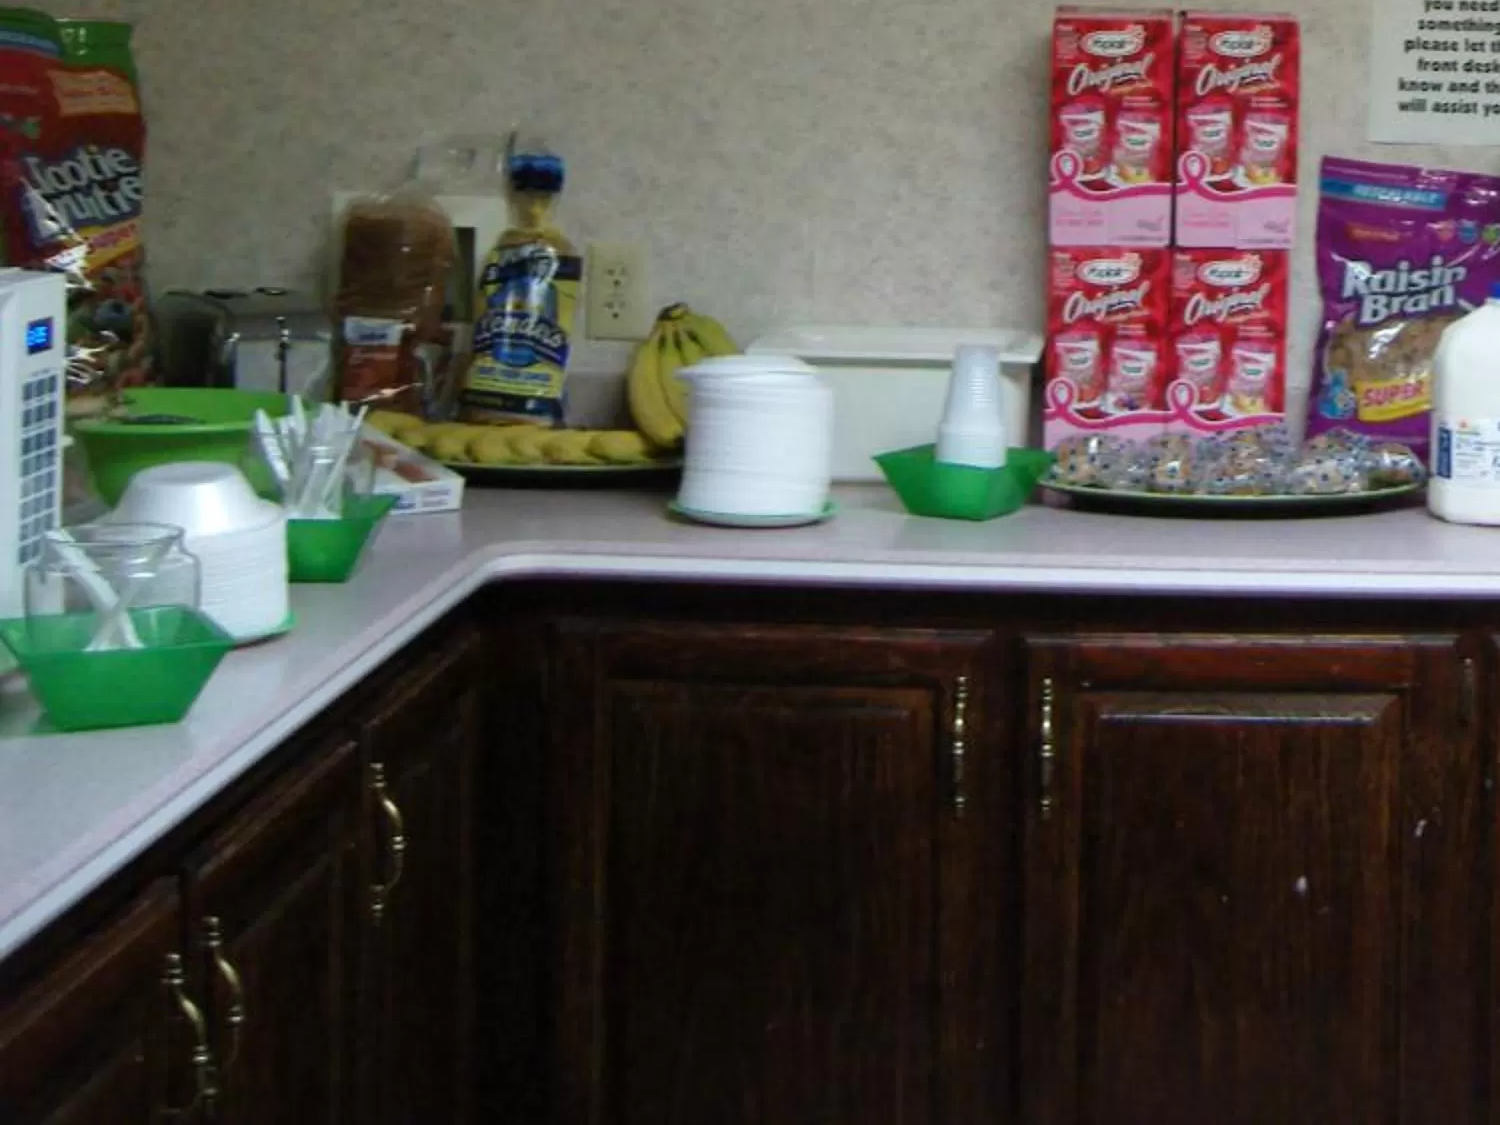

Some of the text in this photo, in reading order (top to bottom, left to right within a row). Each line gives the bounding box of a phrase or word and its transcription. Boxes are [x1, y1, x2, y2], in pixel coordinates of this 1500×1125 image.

[1424, 0, 1500, 13] you need
[1404, 36, 1459, 53] please
[1464, 38, 1486, 53] let
[1417, 57, 1458, 72] front
[1398, 77, 1443, 92] know
[1448, 79, 1480, 93] and
[1398, 98, 1427, 112] will
[1432, 99, 1478, 114] assist
[1342, 254, 1467, 298] Raisin
[1359, 283, 1456, 324] Bran
